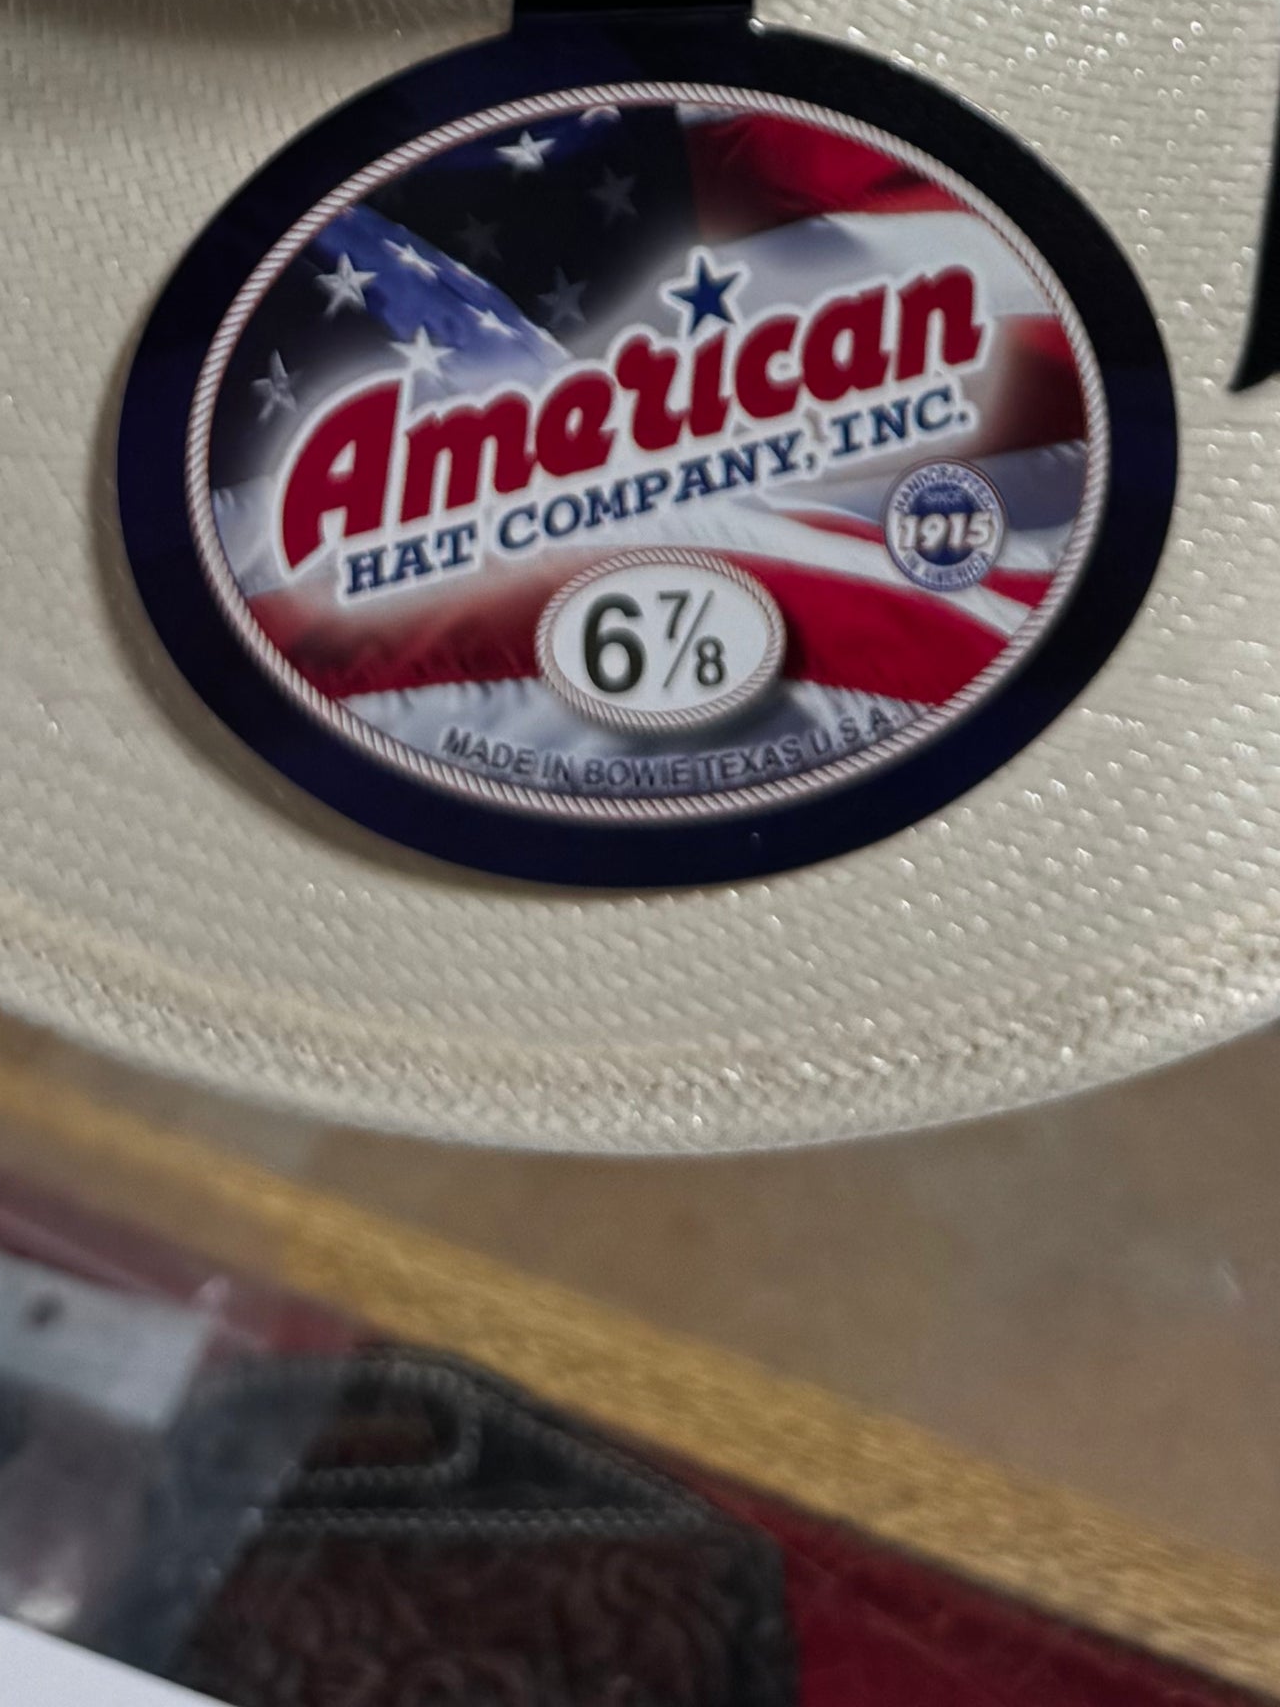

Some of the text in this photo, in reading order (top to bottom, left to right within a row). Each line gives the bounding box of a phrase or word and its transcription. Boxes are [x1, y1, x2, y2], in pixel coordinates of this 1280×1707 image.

[282, 265, 982, 570] American
[346, 387, 972, 594] HAT COMPANY, INC.
[898, 512, 996, 551] 1915
[584, 591, 646, 694] 6
[441, 726, 536, 775] MADE
[542, 751, 574, 781] IN
[584, 756, 691, 786] BOWIE
[698, 736, 803, 783] TEXAS
